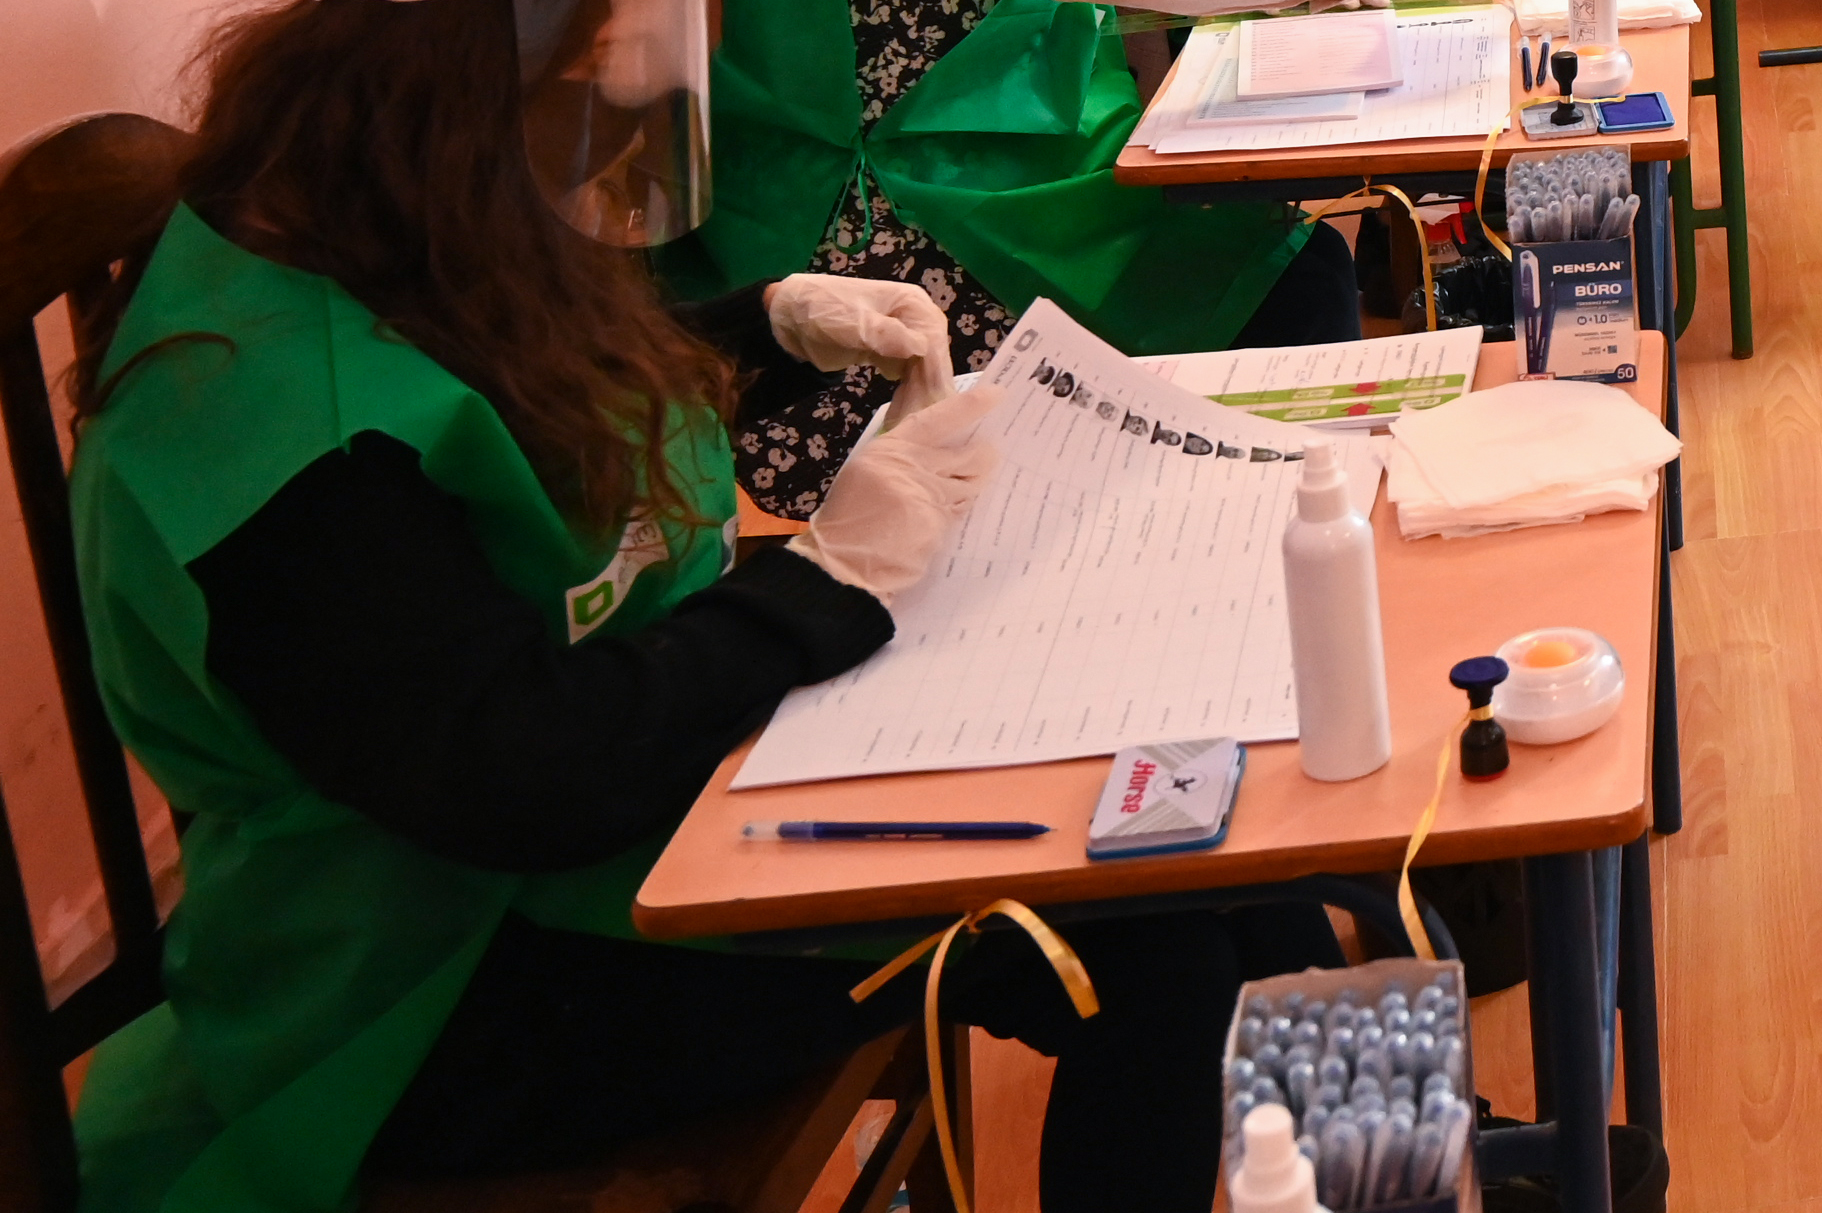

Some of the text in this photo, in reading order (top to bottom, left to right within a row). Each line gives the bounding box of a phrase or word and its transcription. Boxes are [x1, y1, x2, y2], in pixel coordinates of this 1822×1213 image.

[1552, 261, 1621, 275] PENSAN
[1574, 283, 1622, 297] BÜRO
[1594, 314, 1608, 324] 1.0
[1617, 367, 1634, 380] 50
[1120, 759, 1157, 813] Horse
